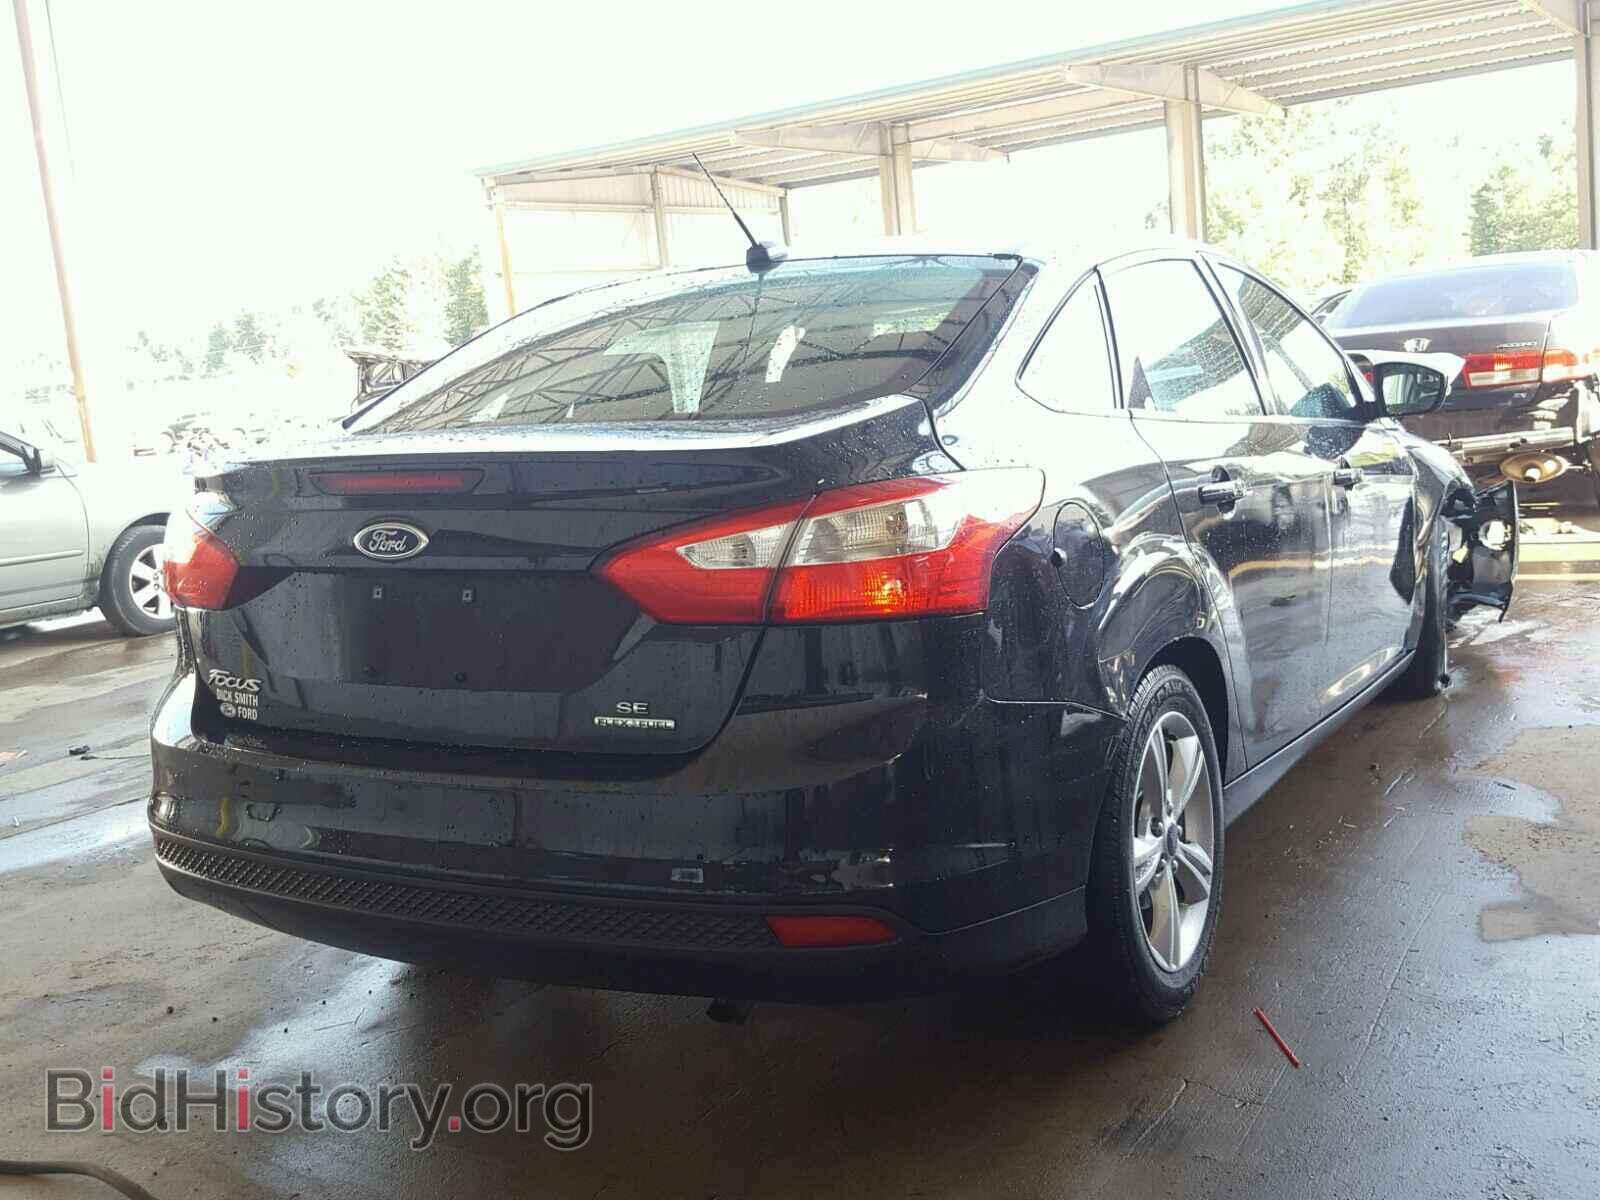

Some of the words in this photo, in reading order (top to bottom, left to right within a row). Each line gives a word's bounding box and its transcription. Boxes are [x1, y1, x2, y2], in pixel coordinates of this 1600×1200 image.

[368, 529, 407, 552] Ford
[234, 691, 259, 707] SMITH
[237, 706, 258, 720] FORD
[616, 701, 648, 714] SE
